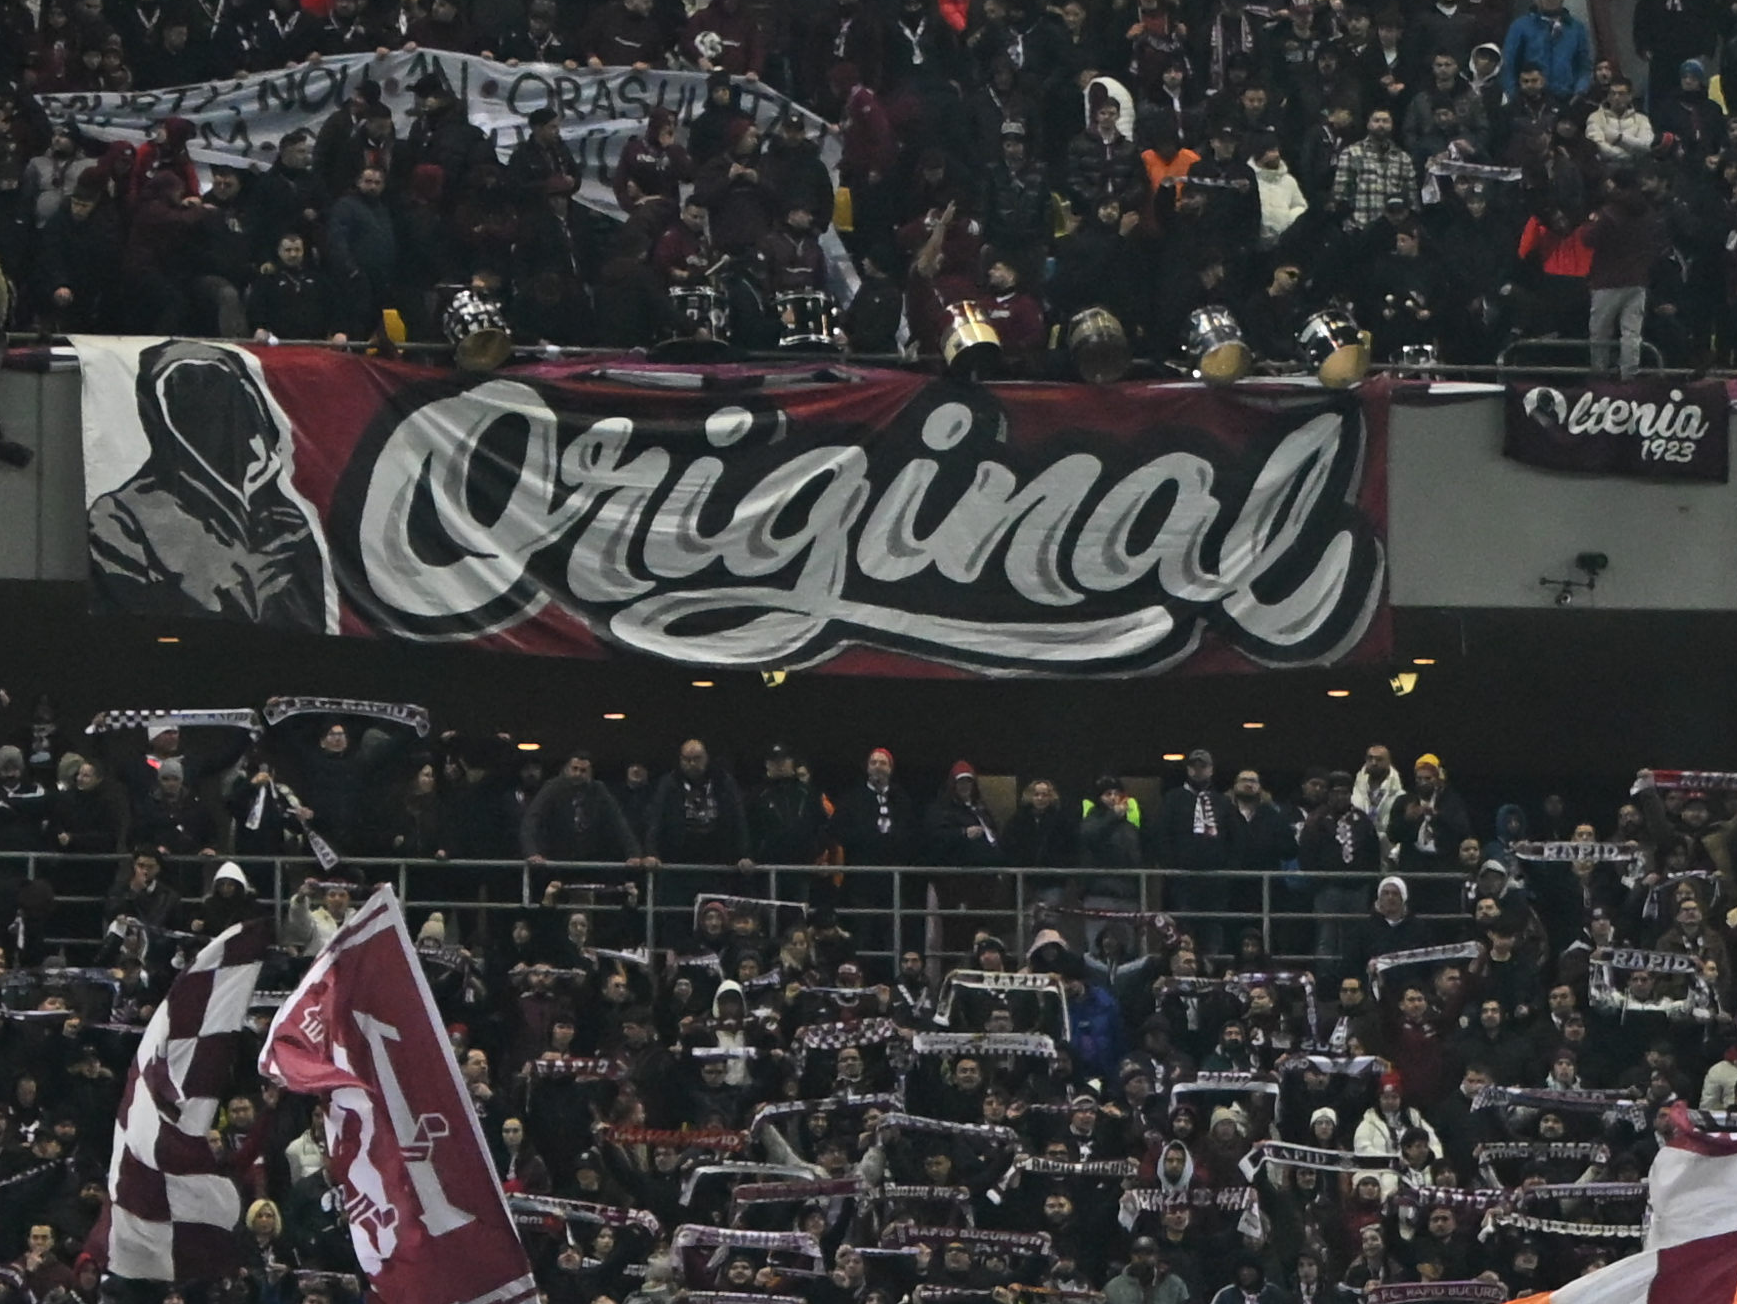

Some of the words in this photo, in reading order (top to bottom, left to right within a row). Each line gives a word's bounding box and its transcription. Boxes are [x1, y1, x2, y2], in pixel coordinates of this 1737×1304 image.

[1525, 385, 1708, 443] Oltenia
[1639, 437, 1696, 464] 1923
[356, 377, 1360, 659] Original
[1543, 843, 1620, 860] RAPID
[1612, 948, 1695, 971] RAPID
